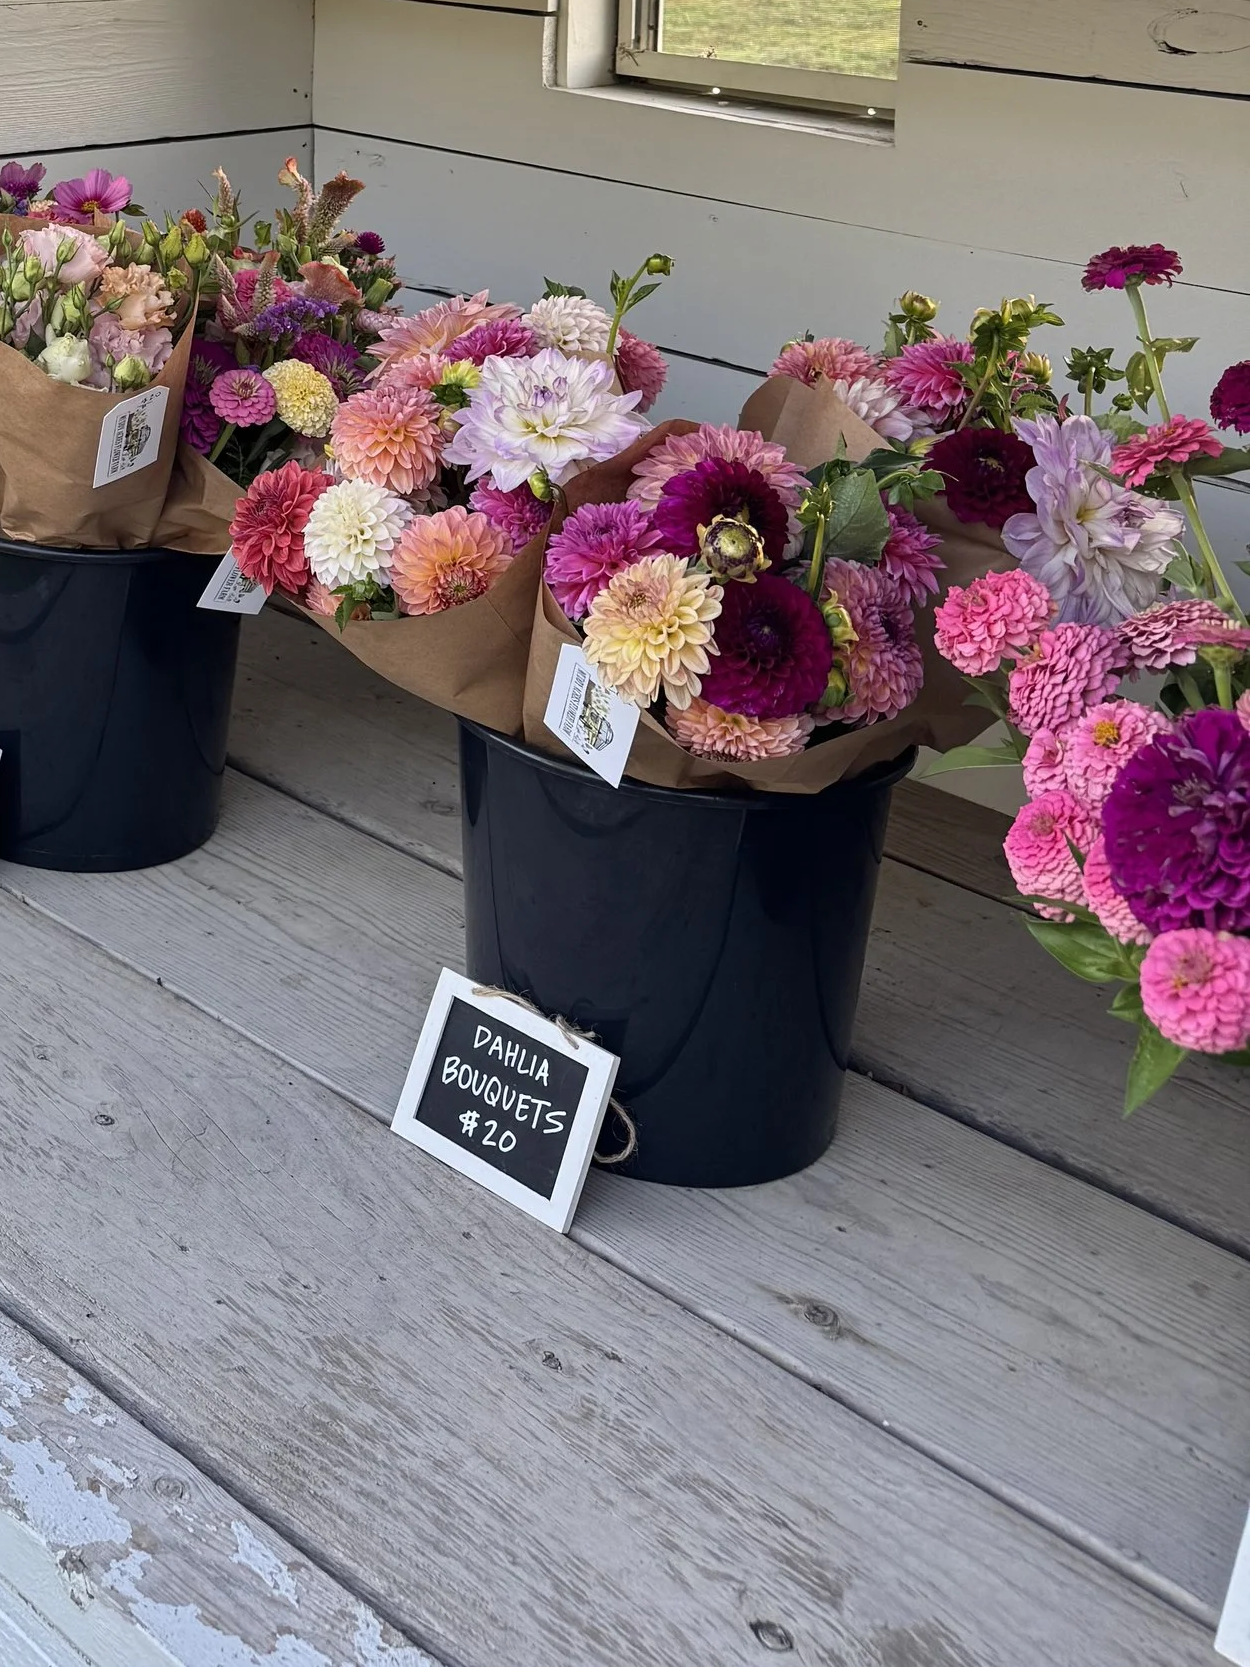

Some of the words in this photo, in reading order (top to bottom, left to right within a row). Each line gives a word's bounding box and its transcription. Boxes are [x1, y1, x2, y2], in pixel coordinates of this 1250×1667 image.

[473, 1024, 550, 1087] DAHLIA
[441, 1055, 567, 1134] BOUQUETS
[458, 1109, 517, 1153] $20
